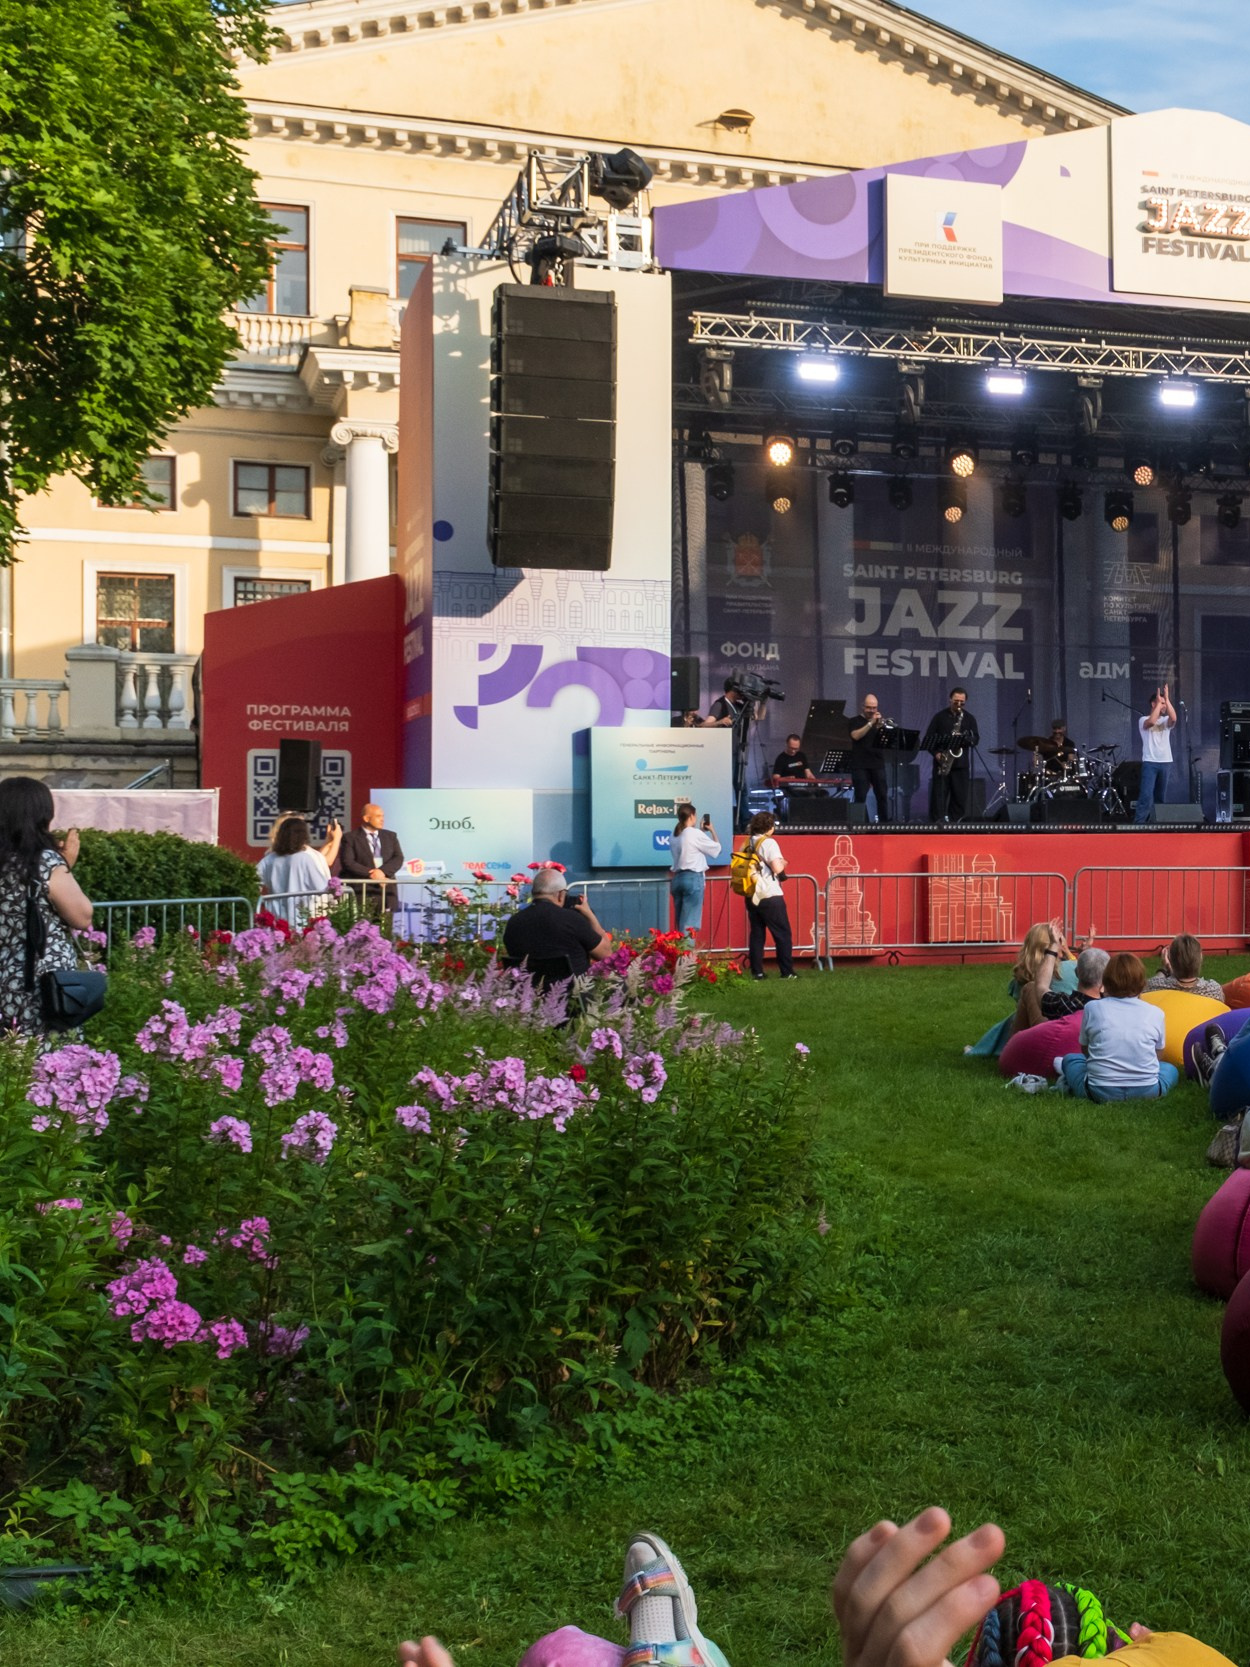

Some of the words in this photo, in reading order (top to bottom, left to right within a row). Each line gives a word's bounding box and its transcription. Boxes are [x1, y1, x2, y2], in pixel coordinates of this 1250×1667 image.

[1140, 185, 1176, 196] SAINT
[898, 248, 964, 259] ПРЕЗИДЕНТСКОГО
[931, 243, 977, 252] ПОДДЕРЖКЕ
[1142, 236, 1250, 262] FESTIVAL
[898, 256, 947, 265] КУЛЬТУРНЫХ
[949, 260, 993, 270] ИНИЦИАТИВ
[915, 544, 1023, 558] МЕЖДУНАРОДНЫЙ
[842, 563, 899, 579] SAINT
[903, 566, 1023, 585] PETERSBURG
[844, 586, 1024, 641] JAZZ
[720, 641, 780, 660] ФОНД
[844, 647, 1025, 680] FESTIVAL
[246, 704, 352, 717] ПРОГРАММА
[248, 719, 349, 732] ФЕСТИВАЛЯ
